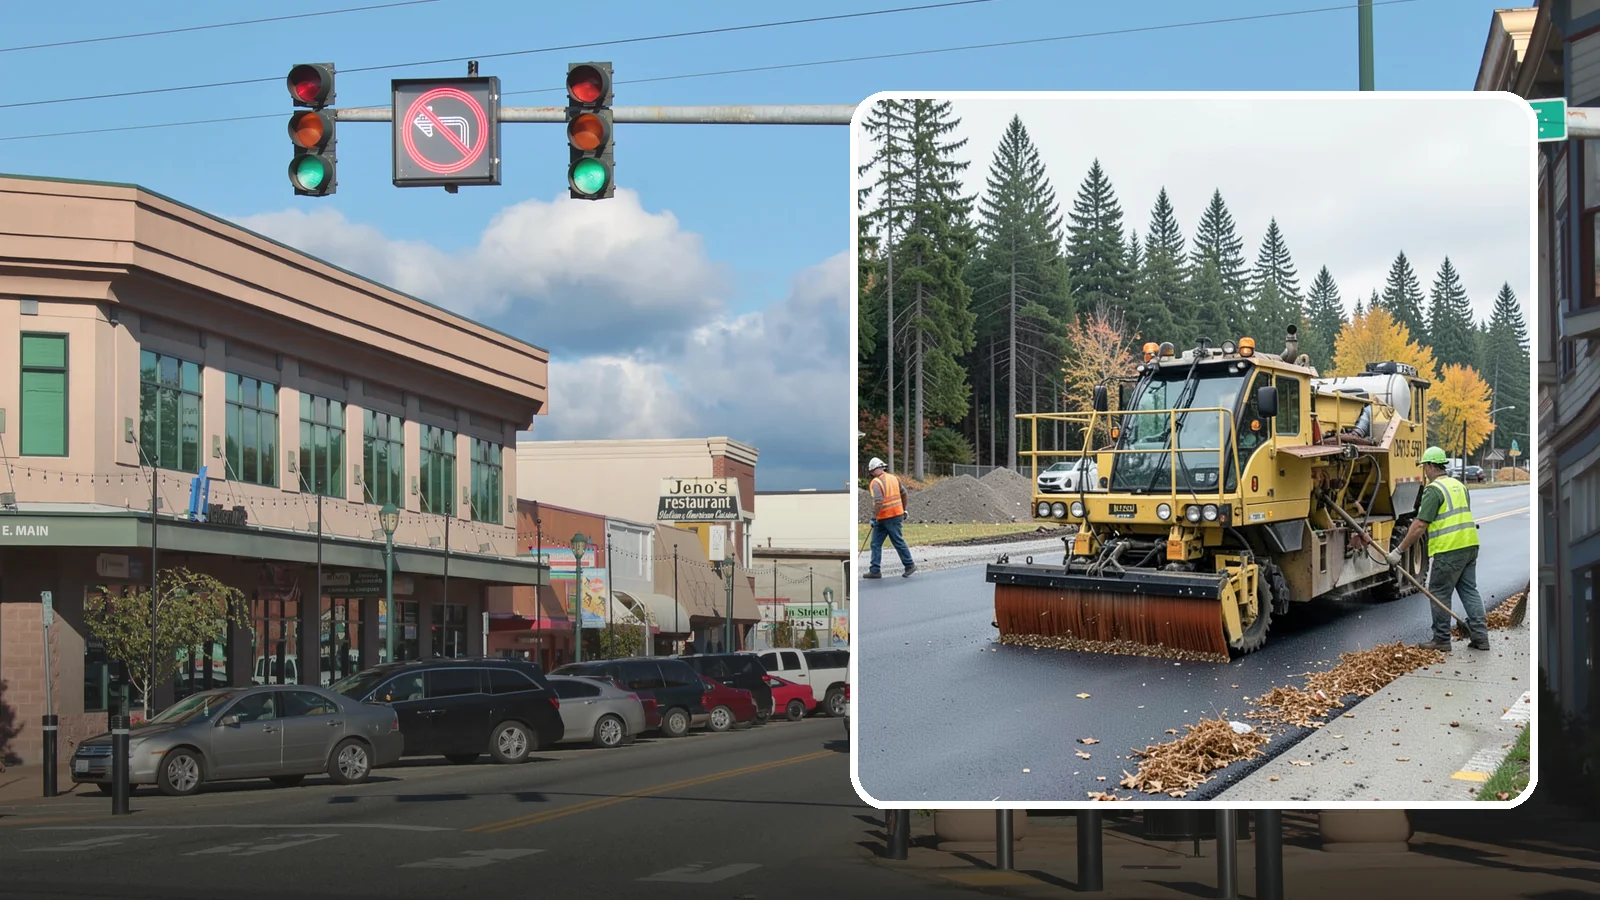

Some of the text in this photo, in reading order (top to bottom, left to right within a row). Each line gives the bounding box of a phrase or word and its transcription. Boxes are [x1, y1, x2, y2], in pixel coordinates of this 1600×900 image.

[670, 480, 728, 494] Jeno's
[665, 496, 731, 509] restaurant
[658, 510, 681, 520] Italian
[686, 509, 714, 519] American
[715, 509, 738, 519] Cuisine
[2, 525, 49, 536] E. MAIN
[797, 607, 828, 617] Street
[791, 619, 823, 627] lass
